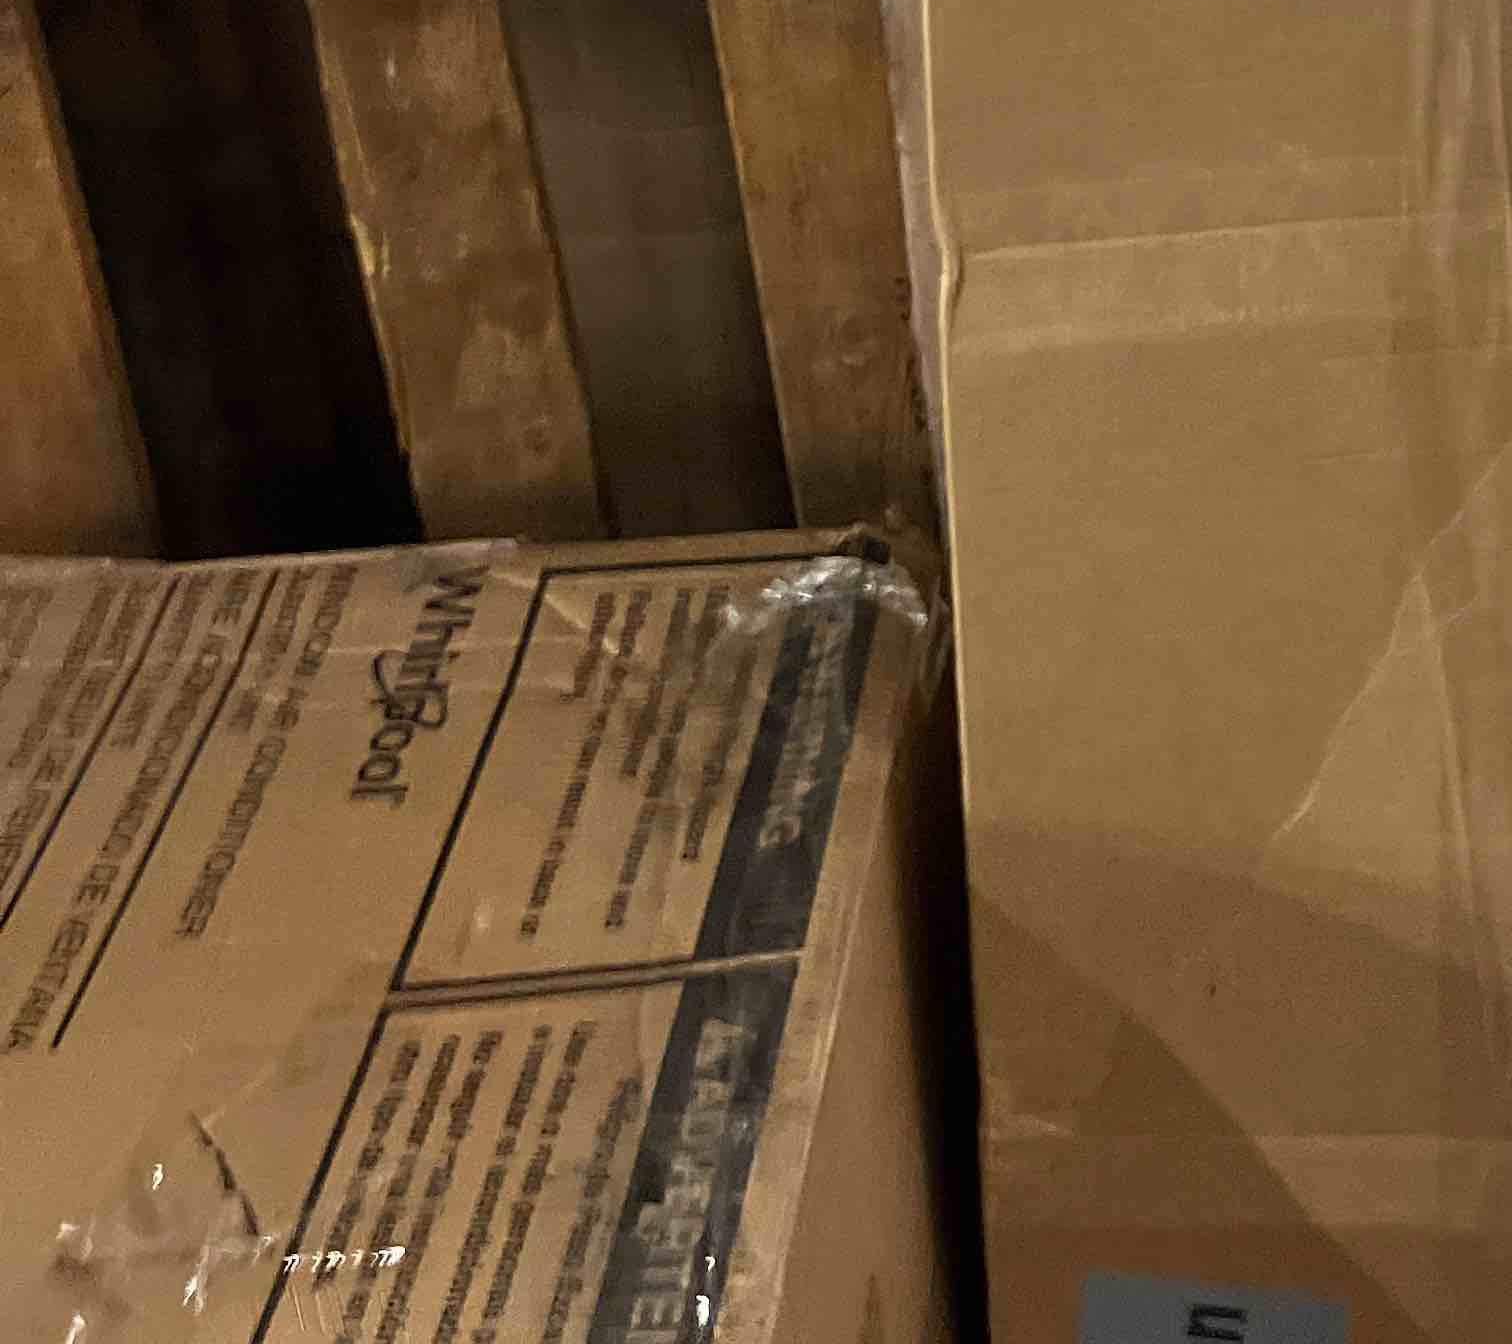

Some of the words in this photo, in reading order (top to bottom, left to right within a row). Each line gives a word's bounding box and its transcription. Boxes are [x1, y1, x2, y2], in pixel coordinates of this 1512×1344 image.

[350, 565, 493, 810] Whirlpool
[75, 863, 122, 907] DE
[2, 918, 91, 1055] VENTANA
